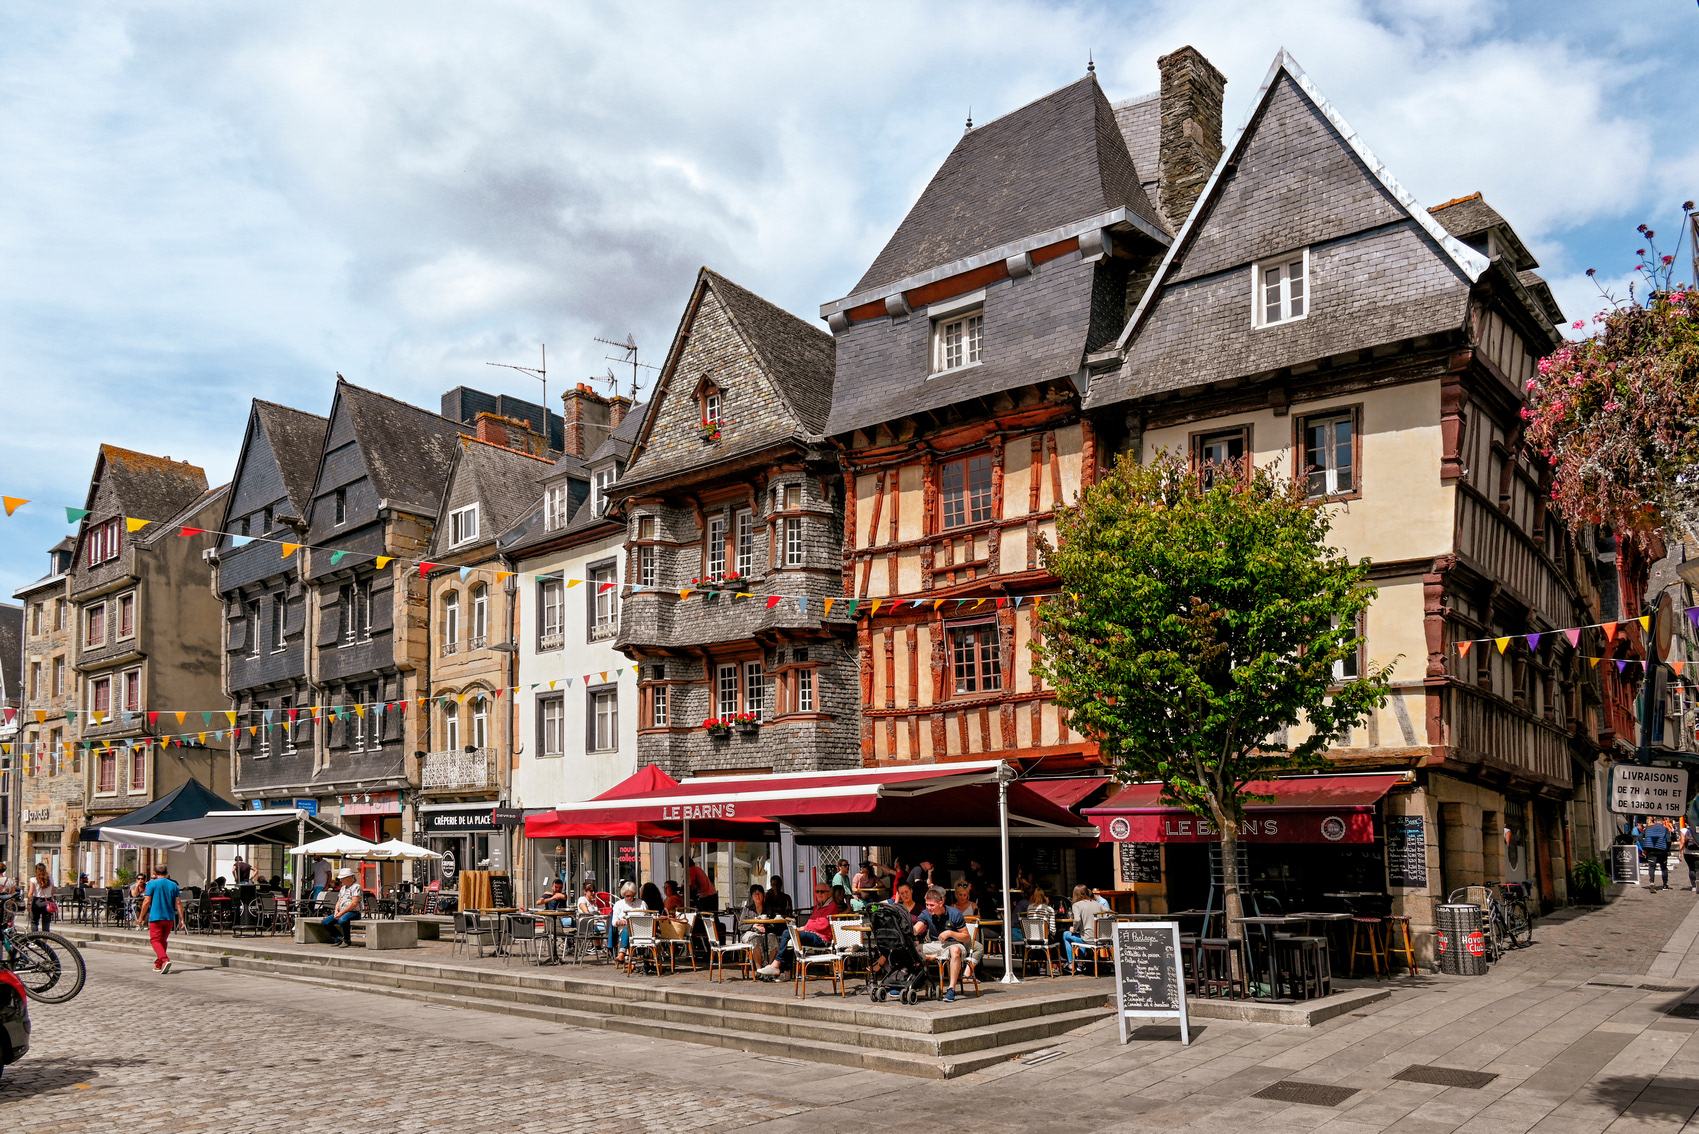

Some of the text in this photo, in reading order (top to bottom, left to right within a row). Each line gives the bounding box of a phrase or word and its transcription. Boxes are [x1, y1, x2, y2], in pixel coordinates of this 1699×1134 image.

[1622, 771, 1679, 783] LIVRAISONS
[1617, 786, 1627, 794] DE
[1630, 786, 1640, 795] 7H
[1672, 789, 1682, 797] ET
[663, 803, 736, 820] LE BARN'S
[1618, 800, 1680, 811] DE 13H30 A 15H
[434, 814, 491, 826] CRÊPERIE DE LA PLACE
[1165, 820, 1279, 836] LE BN'S
